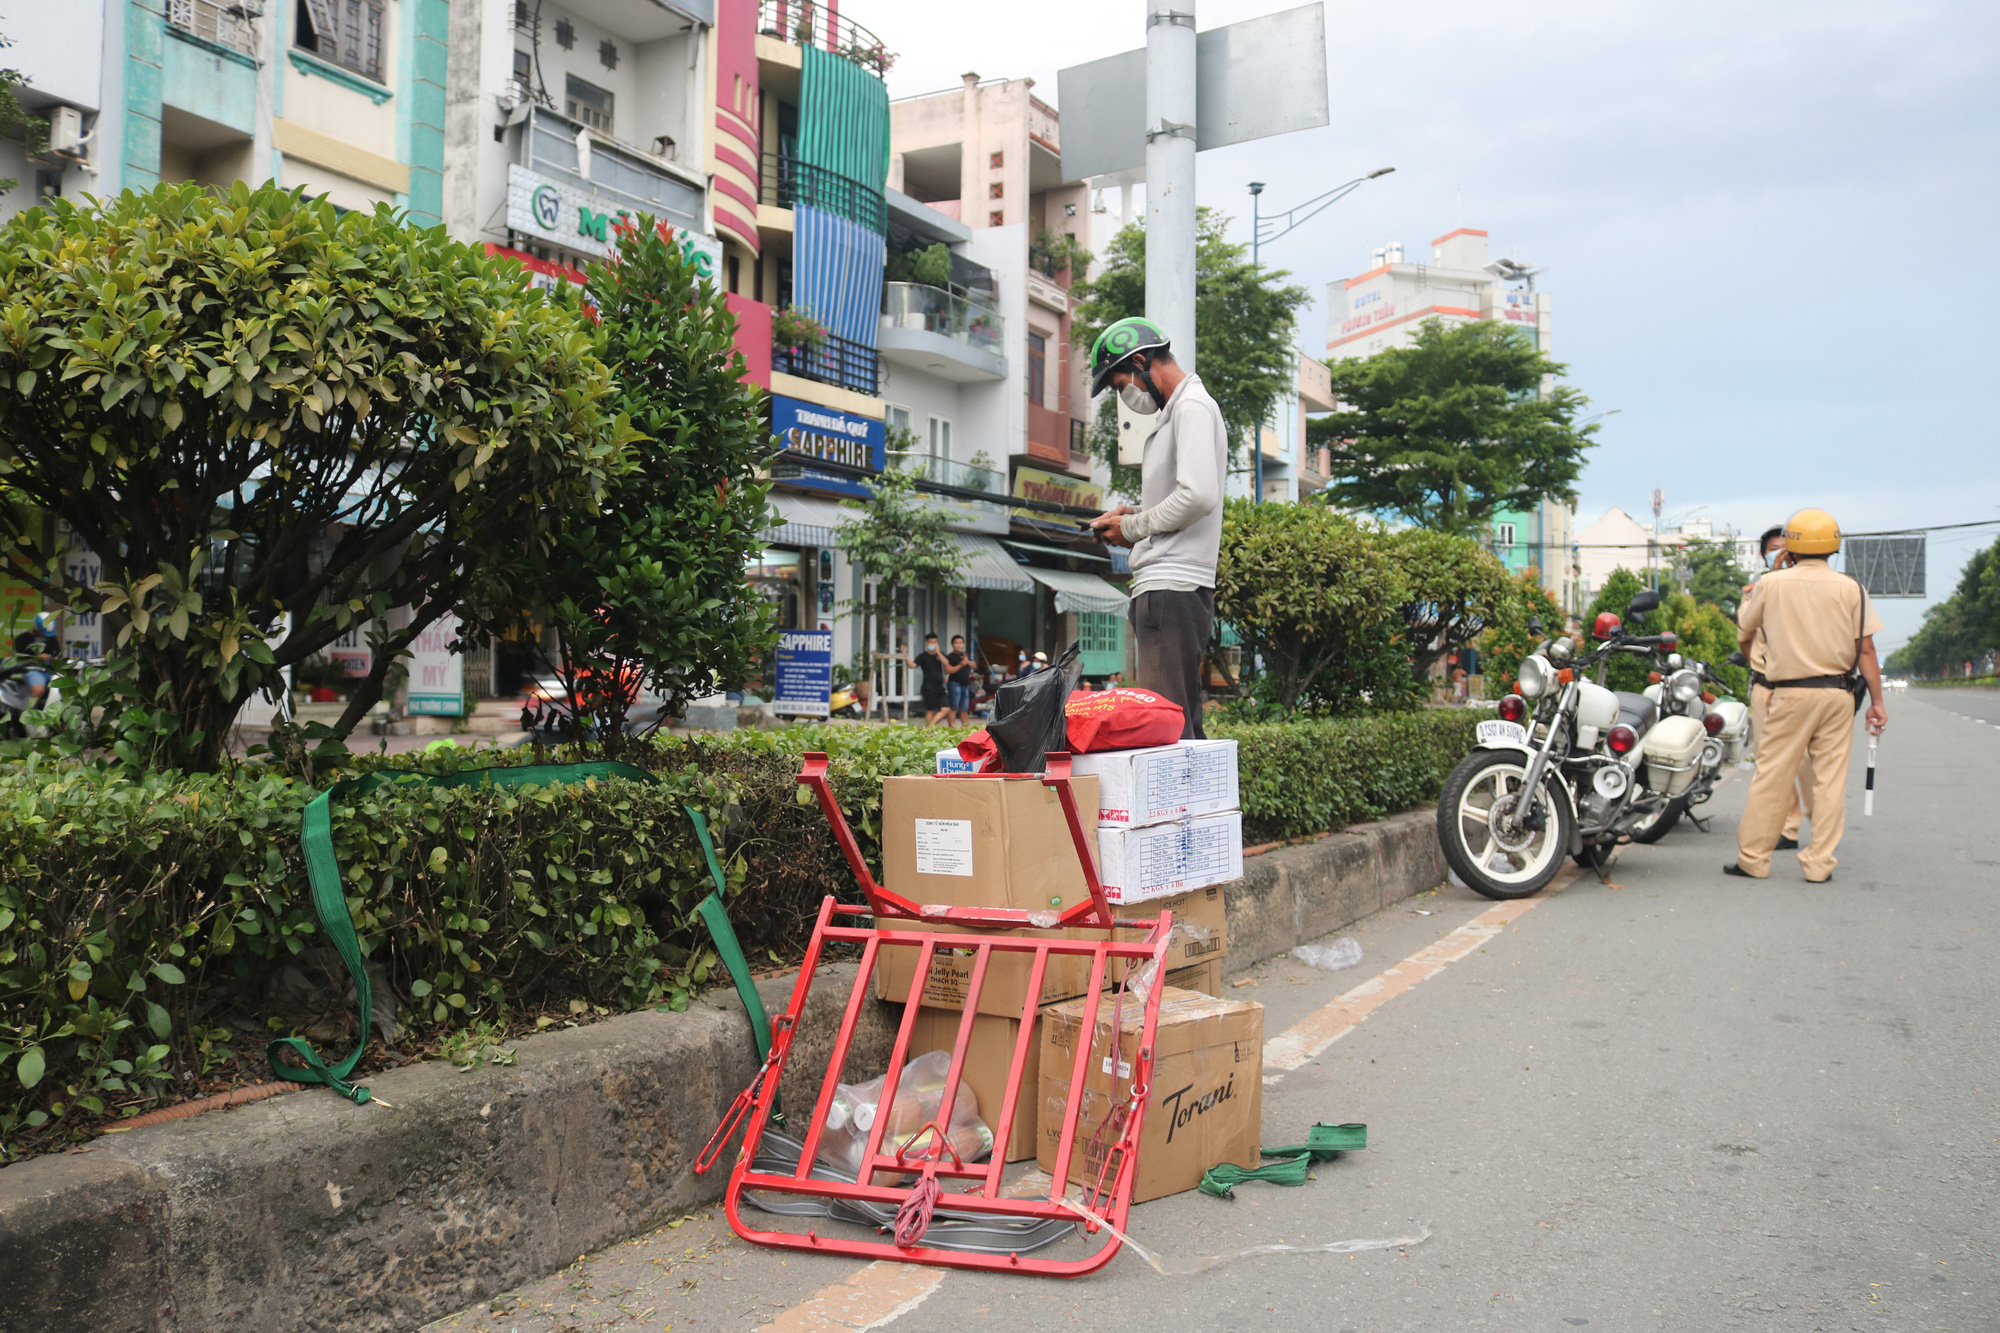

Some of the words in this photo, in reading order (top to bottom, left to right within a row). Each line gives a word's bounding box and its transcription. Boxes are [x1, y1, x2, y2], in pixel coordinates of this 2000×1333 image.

[787, 427, 874, 468] SAPPHIRE
[778, 634, 832, 651] SAPPHIRE
[423, 662, 447, 687] MỸ
[1157, 809, 1168, 817] KGS
[1151, 884, 1163, 892] KGS
[934, 968, 950, 978] Jelly
[951, 969, 968, 978] Pearl
[1163, 1073, 1234, 1145] Torani
[1047, 1128, 1079, 1144] LYCE
